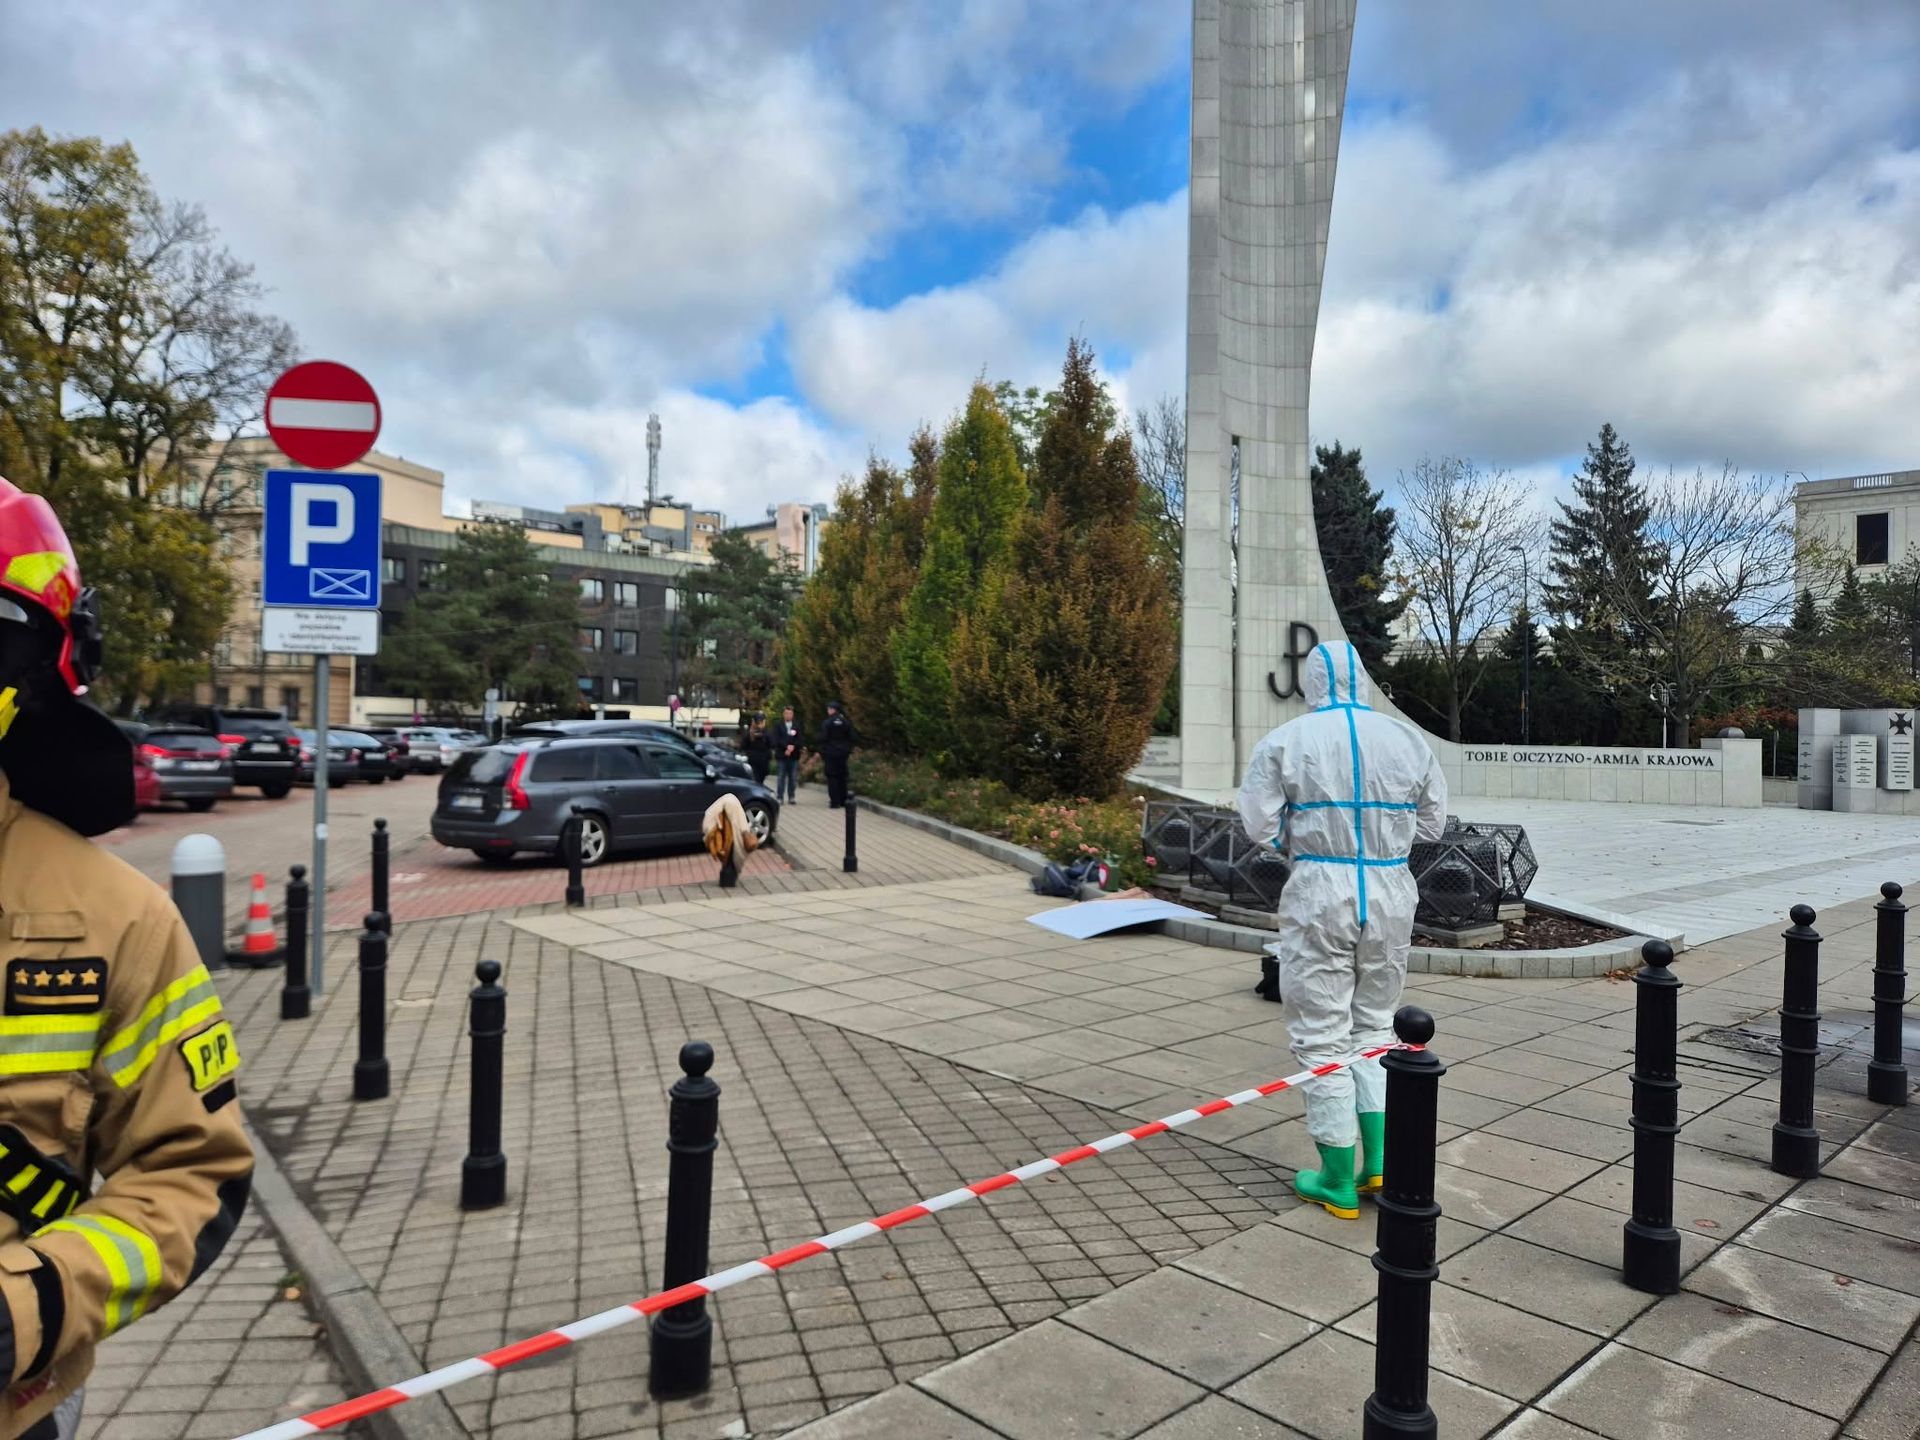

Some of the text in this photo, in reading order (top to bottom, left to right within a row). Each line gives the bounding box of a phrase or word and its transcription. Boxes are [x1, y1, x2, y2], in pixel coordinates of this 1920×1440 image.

[289, 482, 355, 567] P
[1464, 750, 1508, 762] TOBIE
[1646, 754, 1714, 767] KRAJOWA
